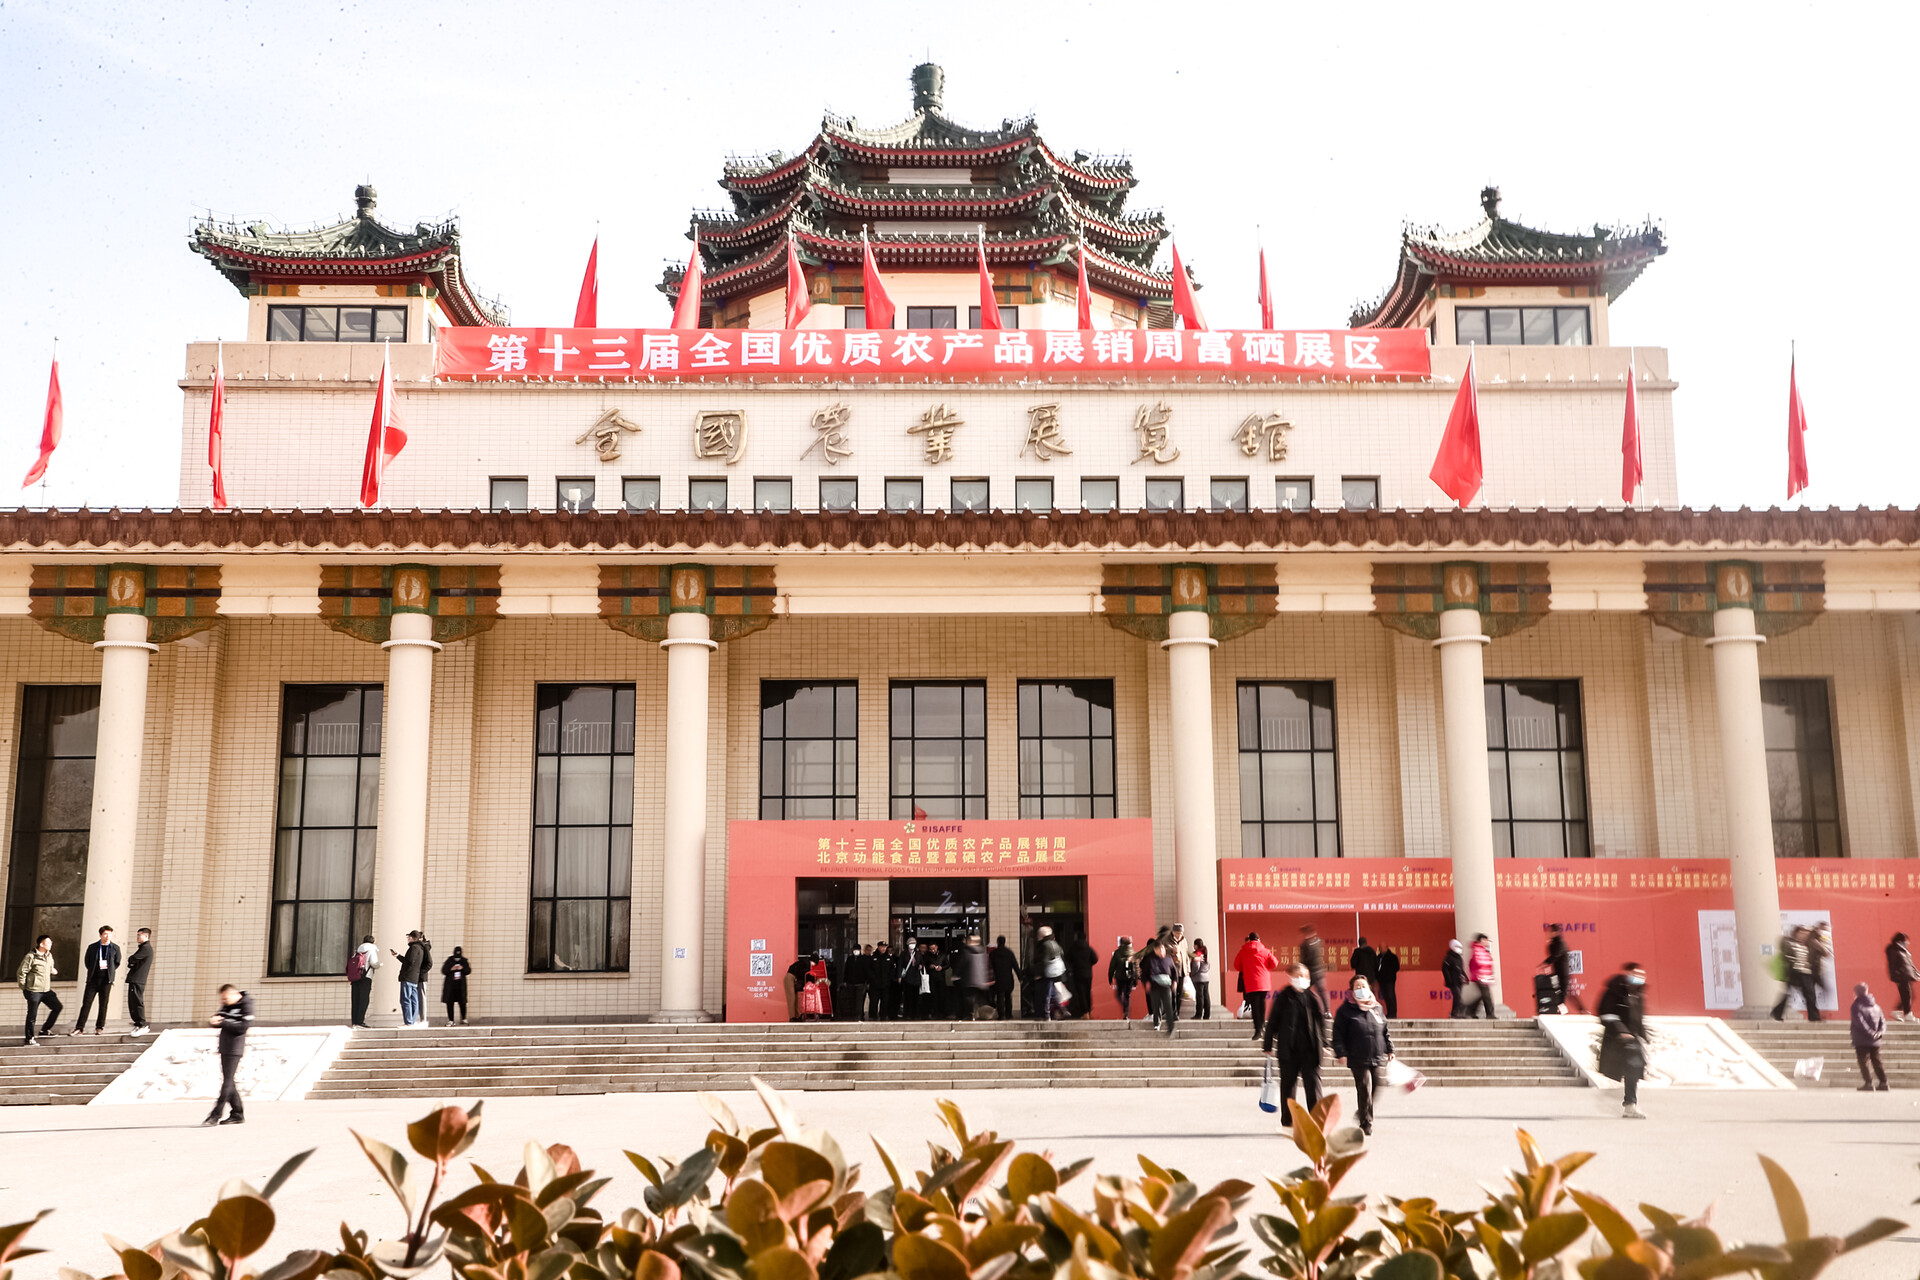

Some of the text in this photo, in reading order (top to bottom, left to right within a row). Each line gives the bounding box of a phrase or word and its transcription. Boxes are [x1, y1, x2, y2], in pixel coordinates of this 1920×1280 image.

[485, 330, 1384, 372] 第十三届全国优质农产品展销周富硒展区
[817, 837, 1066, 851] 第十三届全国优质农产品展销周
[817, 850, 1066, 864] 北京功能食品暨富硒农产品展区
